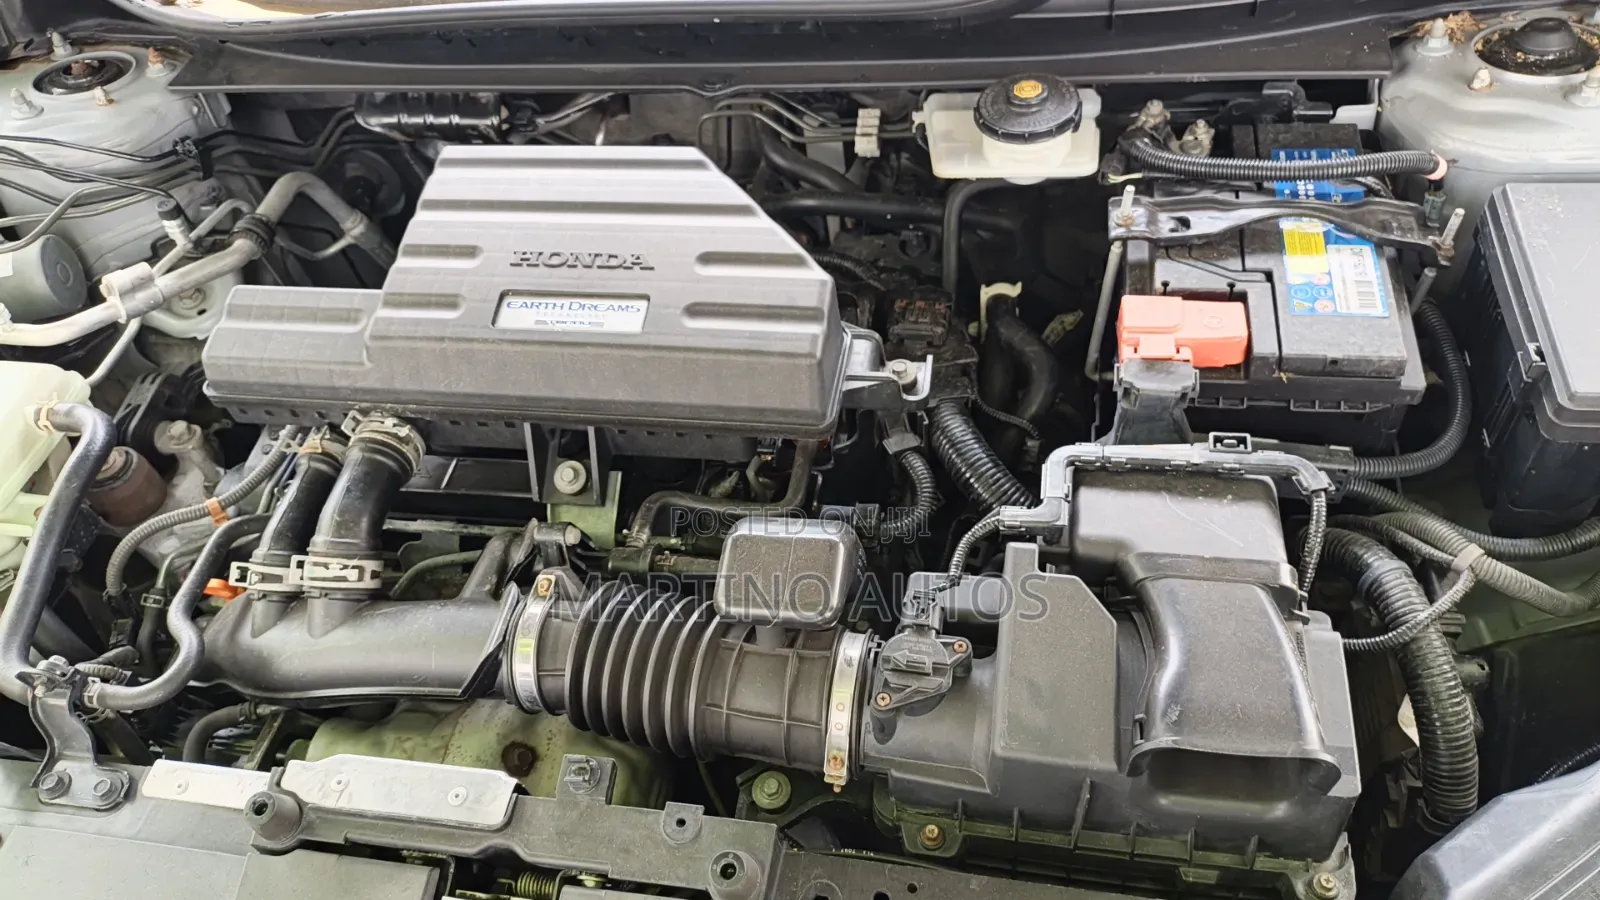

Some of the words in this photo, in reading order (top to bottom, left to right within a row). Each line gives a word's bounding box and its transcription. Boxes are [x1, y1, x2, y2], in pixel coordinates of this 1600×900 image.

[509, 250, 655, 271] HONDA
[506, 300, 564, 311] EARTH
[568, 301, 641, 313] DREAMS
